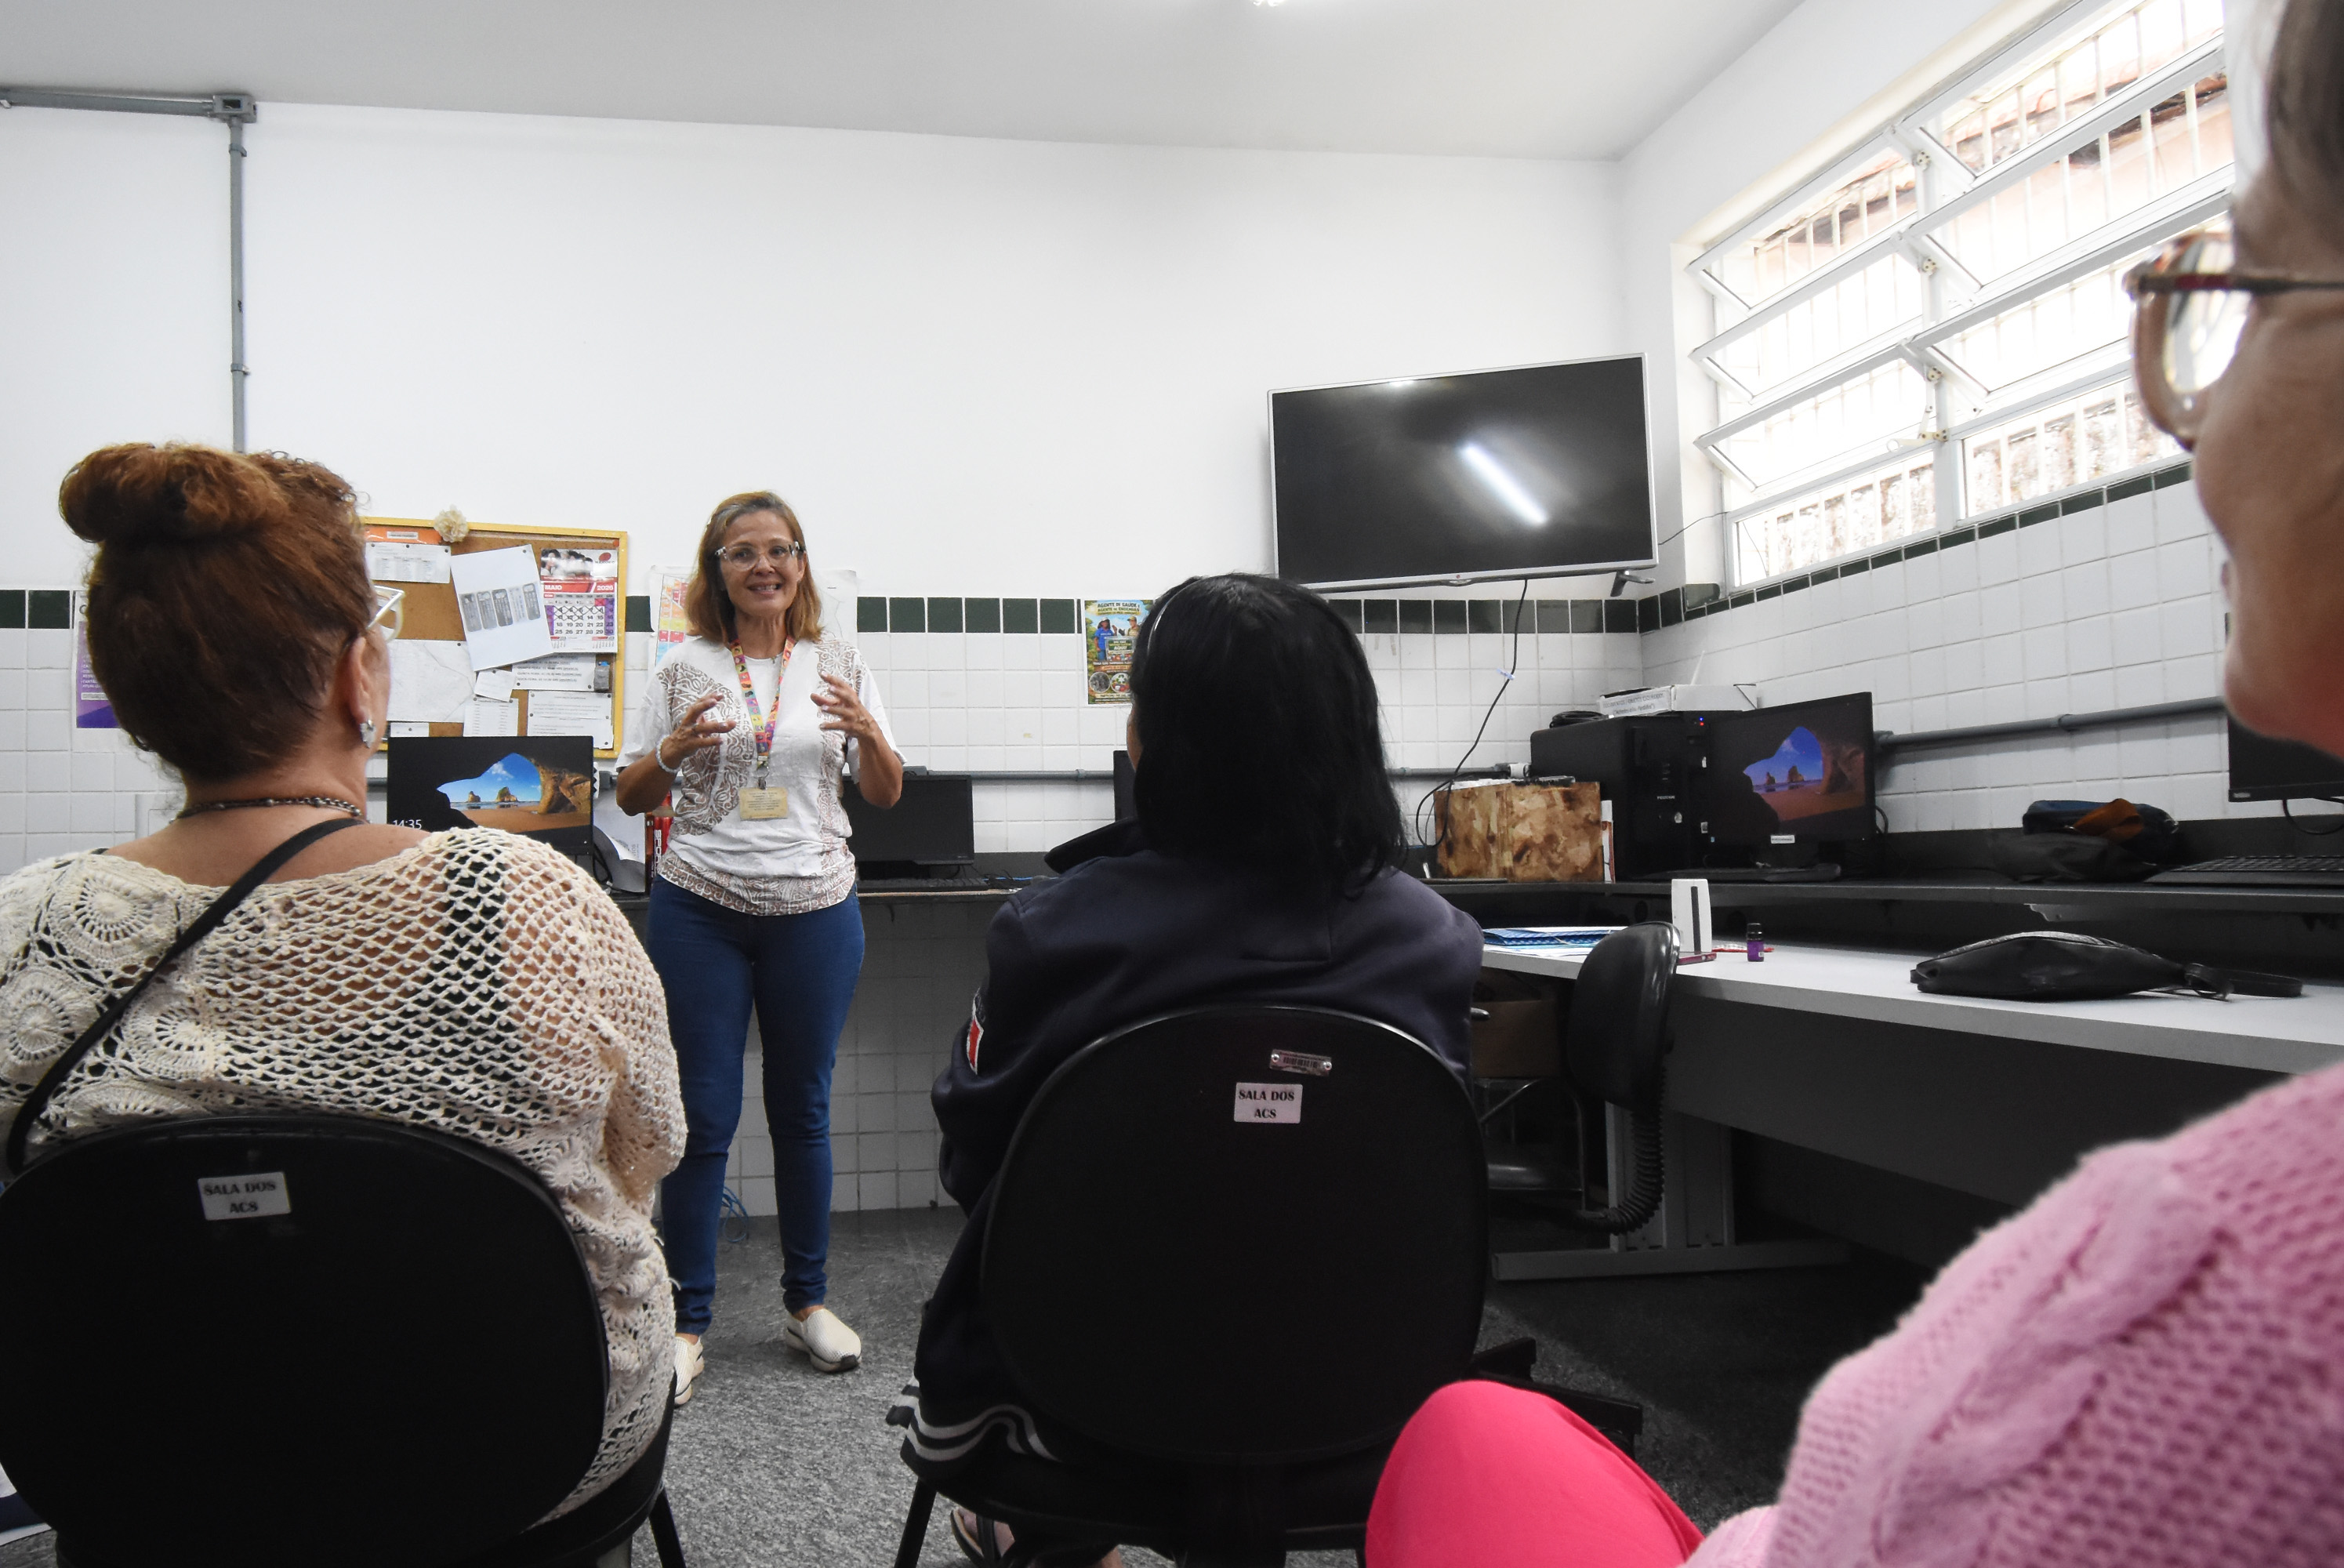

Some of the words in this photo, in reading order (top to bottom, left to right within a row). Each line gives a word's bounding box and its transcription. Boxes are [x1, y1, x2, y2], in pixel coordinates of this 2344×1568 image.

[1239, 1091, 1267, 1101] SALA
[1271, 1091, 1295, 1102] DOS
[1254, 1109, 1277, 1119] ACS
[204, 1183, 240, 1196] SALA
[245, 1181, 277, 1192] DOS
[230, 1201, 259, 1214] ACS
